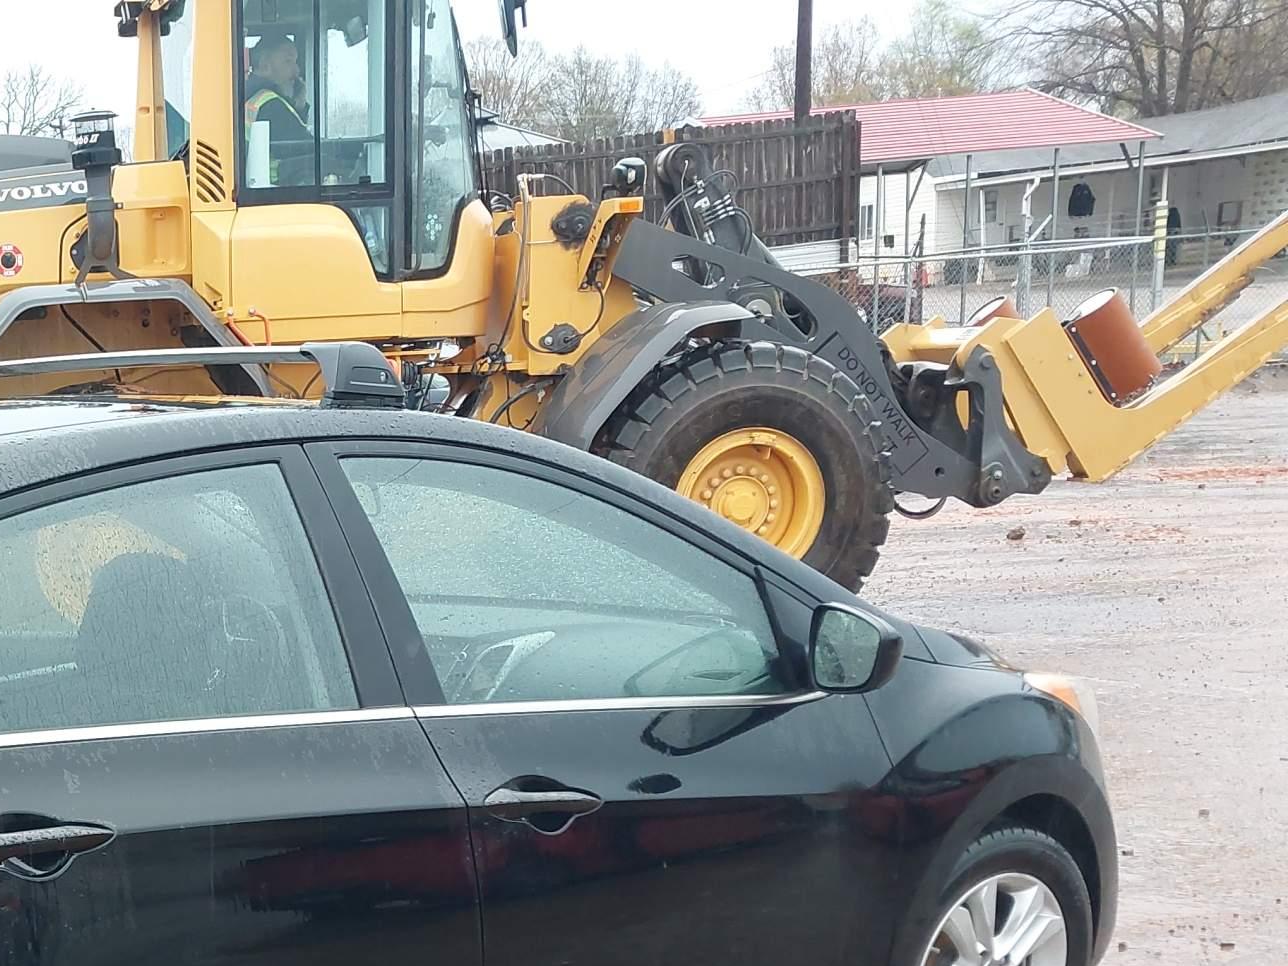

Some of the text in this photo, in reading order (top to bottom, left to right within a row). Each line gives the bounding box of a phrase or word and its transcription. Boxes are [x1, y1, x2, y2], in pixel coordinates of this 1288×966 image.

[838, 347, 858, 371] DO
[856, 371, 885, 401] NOT
[882, 402, 916, 446] WALK
